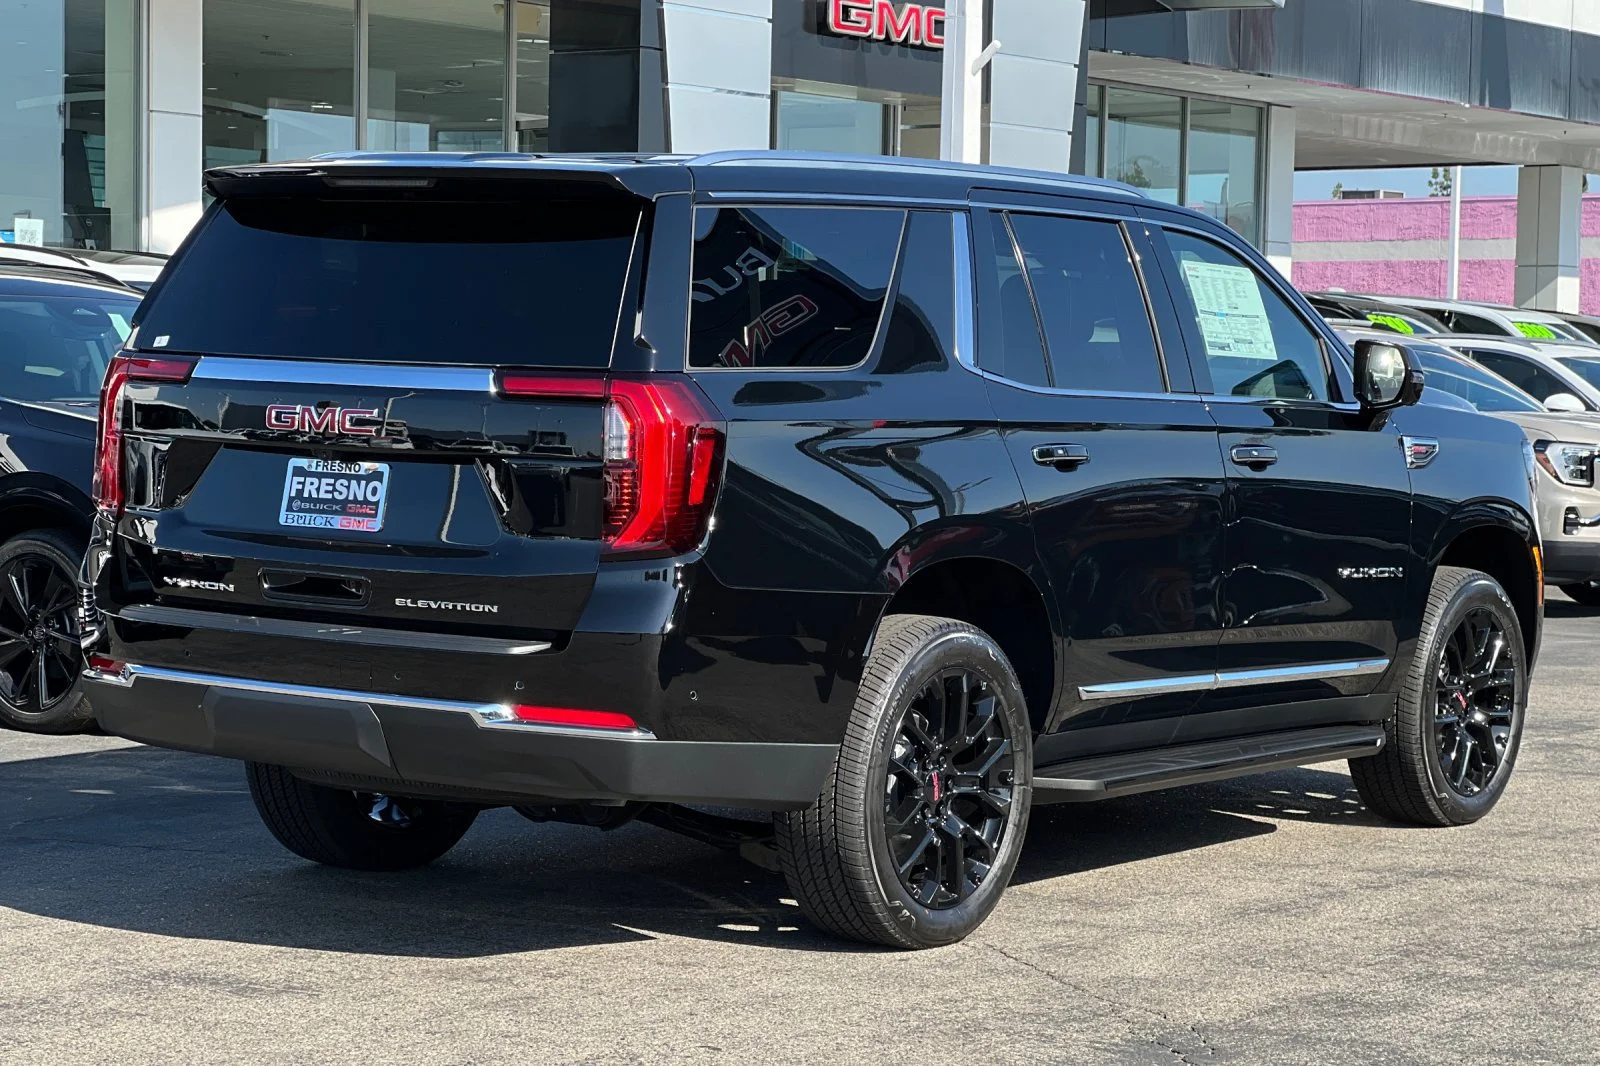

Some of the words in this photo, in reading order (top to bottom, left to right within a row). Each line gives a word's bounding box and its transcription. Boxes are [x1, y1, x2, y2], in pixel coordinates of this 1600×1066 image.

[266, 404, 379, 436] GMC
[315, 460, 362, 473] FRESNO
[290, 476, 382, 502] FRESNO
[301, 502, 342, 511] BUICK
[345, 503, 377, 514] GMC
[284, 513, 336, 527] BUICK
[339, 516, 377, 531] GMC
[394, 598, 499, 613] ELEVATION
